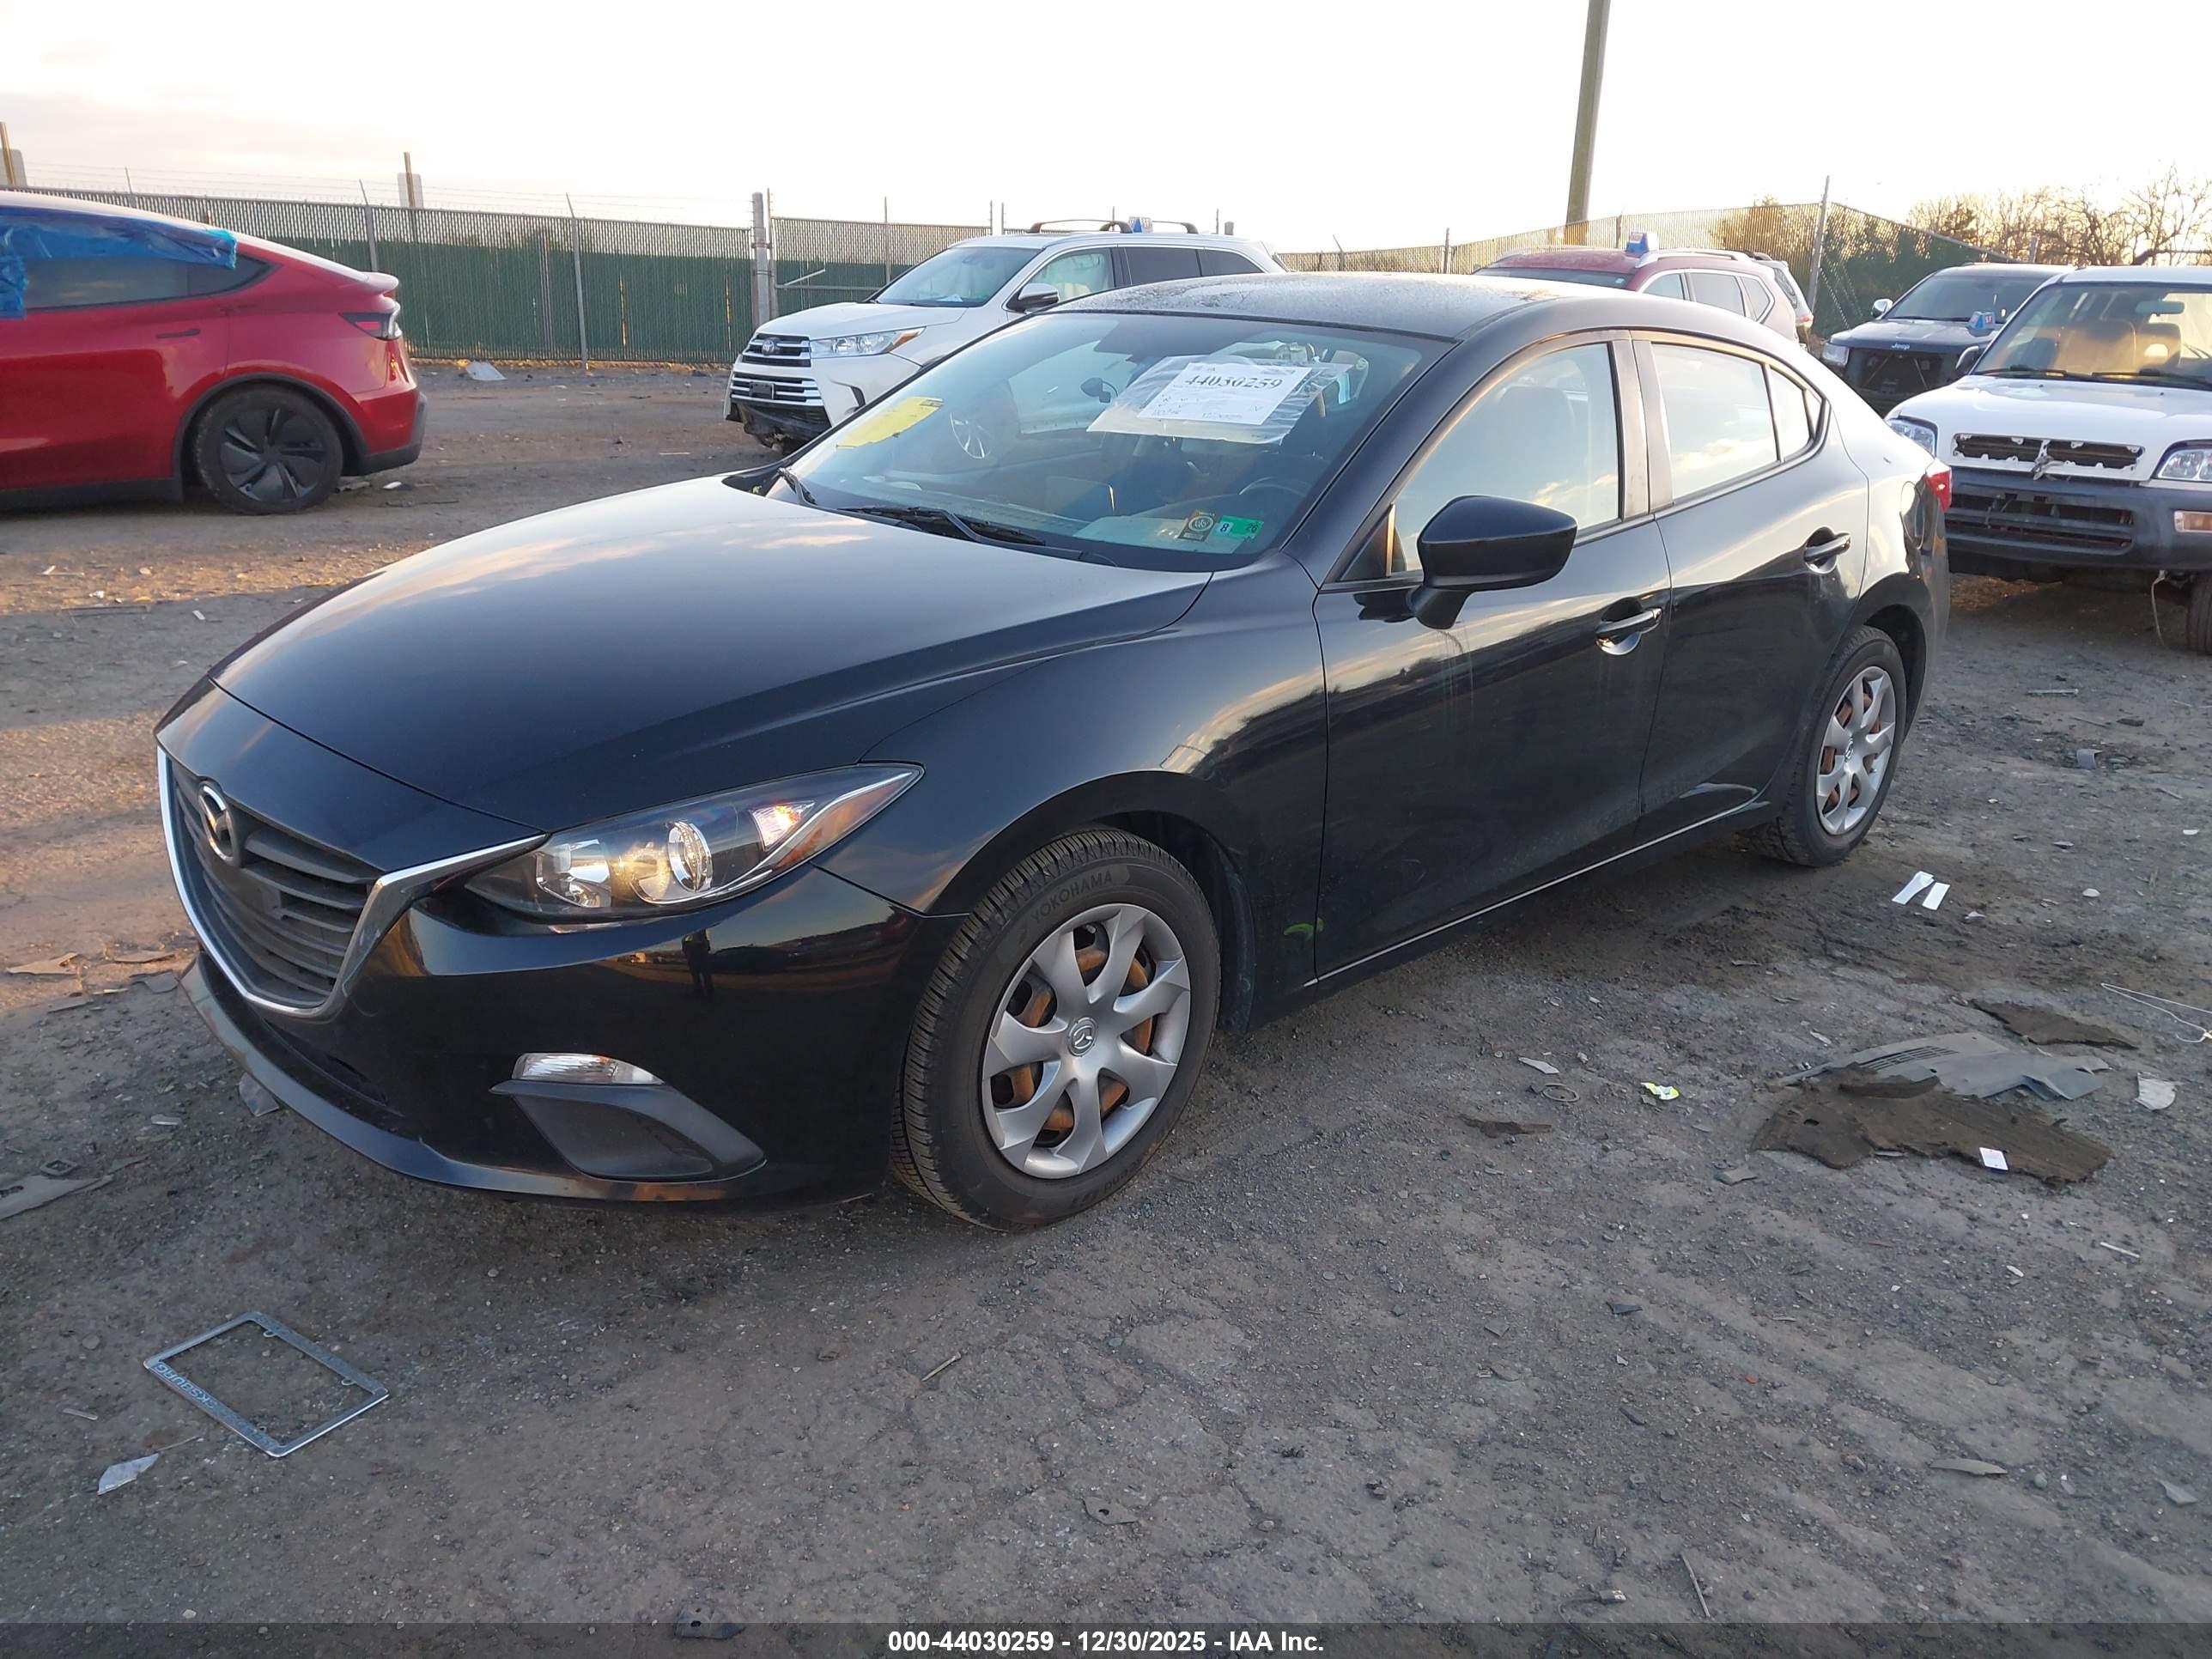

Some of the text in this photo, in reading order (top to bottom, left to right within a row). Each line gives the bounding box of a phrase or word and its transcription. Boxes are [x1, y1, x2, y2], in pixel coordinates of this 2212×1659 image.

[1185, 374, 1284, 389] 44030259
[1219, 523, 1230, 533] 8
[1030, 871, 1113, 923] YOKOHAMA
